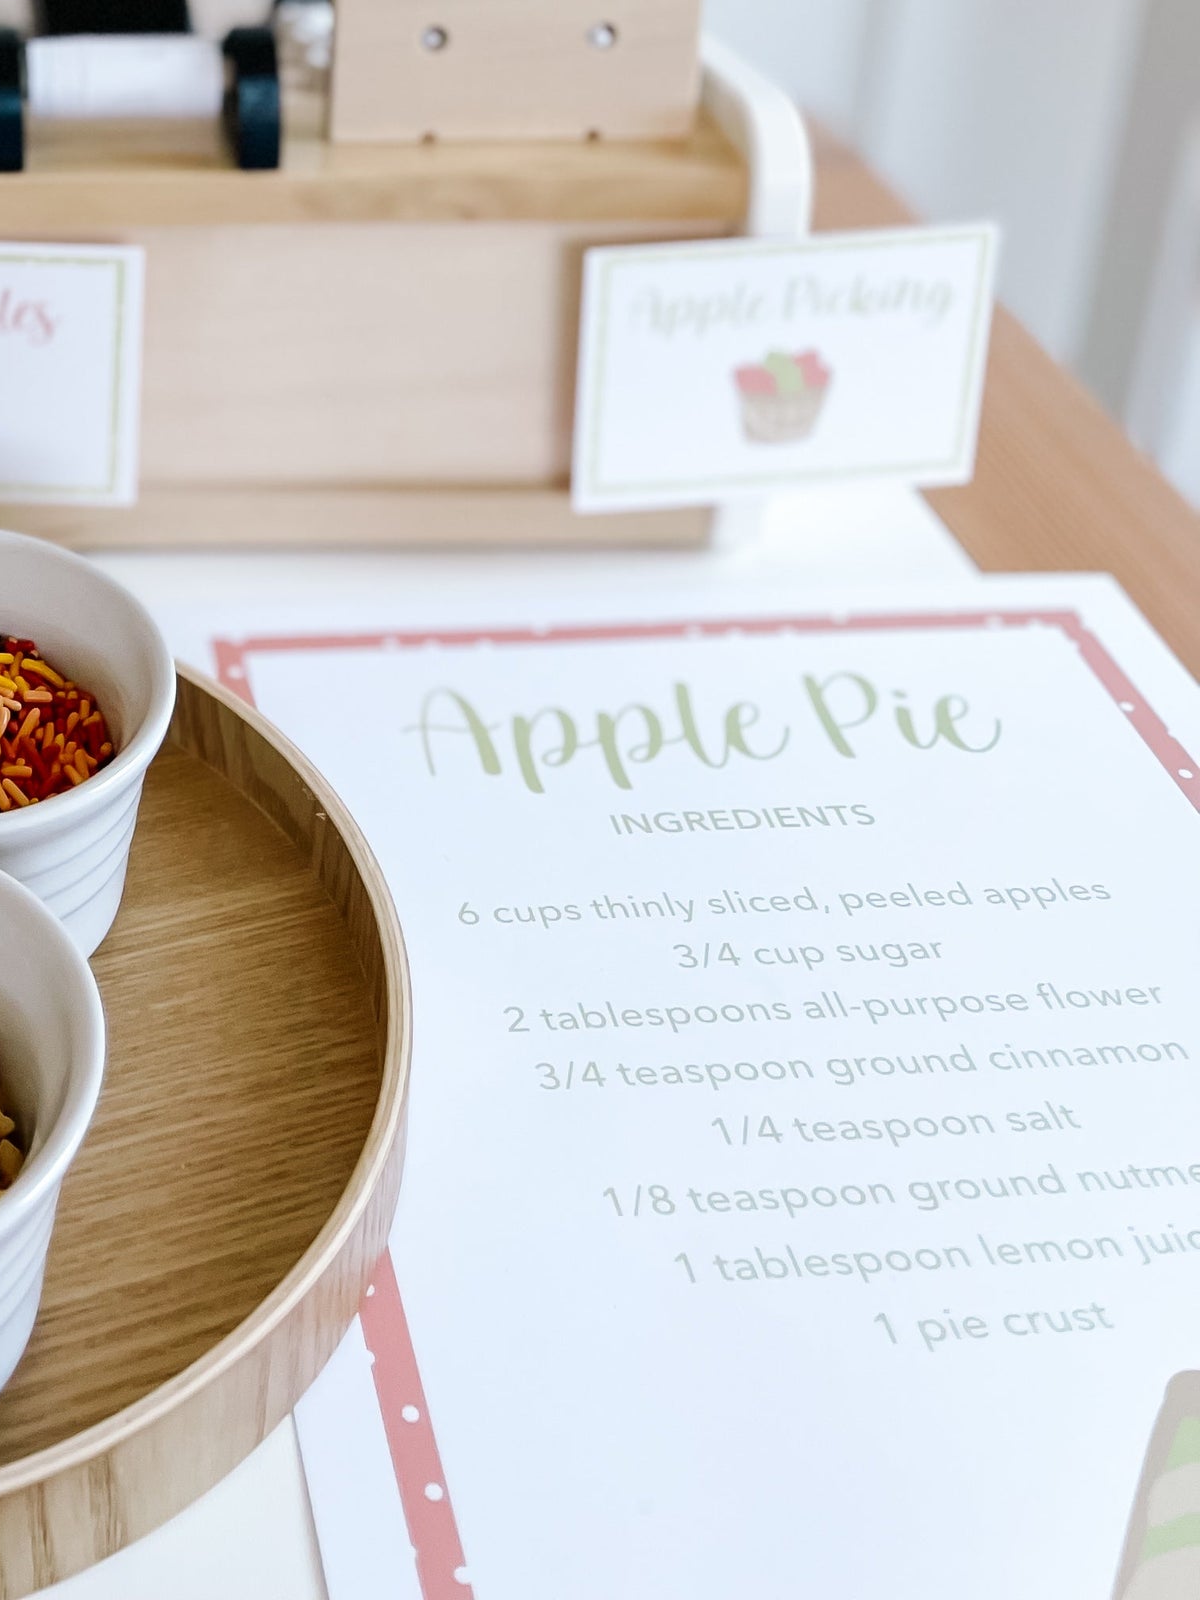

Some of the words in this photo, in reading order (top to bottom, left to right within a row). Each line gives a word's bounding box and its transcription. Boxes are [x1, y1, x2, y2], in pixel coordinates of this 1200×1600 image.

[628, 280, 764, 336] Apple
[783, 269, 952, 326] Picking
[403, 681, 791, 794] Apple
[801, 671, 1002, 759] Pie
[610, 804, 876, 835] INGREDIENTS
[458, 902, 480, 925] 6
[493, 904, 582, 929] cups
[590, 892, 694, 923] thinly
[708, 886, 830, 914] sliced,
[838, 881, 973, 915] peeled
[983, 878, 1111, 910] apples
[673, 942, 741, 968] 3/4
[754, 946, 825, 971] cup
[836, 942, 941, 968] sugar
[503, 1006, 530, 1032] 2
[539, 1001, 792, 1033] tablespoons
[803, 991, 1029, 1025] all-purpose
[1036, 982, 1161, 1010] flower
[535, 1061, 606, 1090] 3/4
[616, 1060, 814, 1091] teaspoon
[826, 1044, 978, 1086] ground
[989, 1042, 1189, 1070] cinnamon
[711, 1115, 783, 1146] 1/4
[792, 1114, 995, 1147] teaspoon
[1006, 1101, 1082, 1132] salt
[603, 1184, 676, 1217] 1/8
[687, 1183, 895, 1218] teaspoon
[908, 1163, 1067, 1211] ground
[674, 1253, 696, 1283] 1
[713, 1245, 972, 1283] tablespoon
[977, 1234, 1124, 1265] lemon
[874, 1312, 897, 1344] 1
[917, 1309, 989, 1352] pie
[1003, 1302, 1114, 1336] crust
